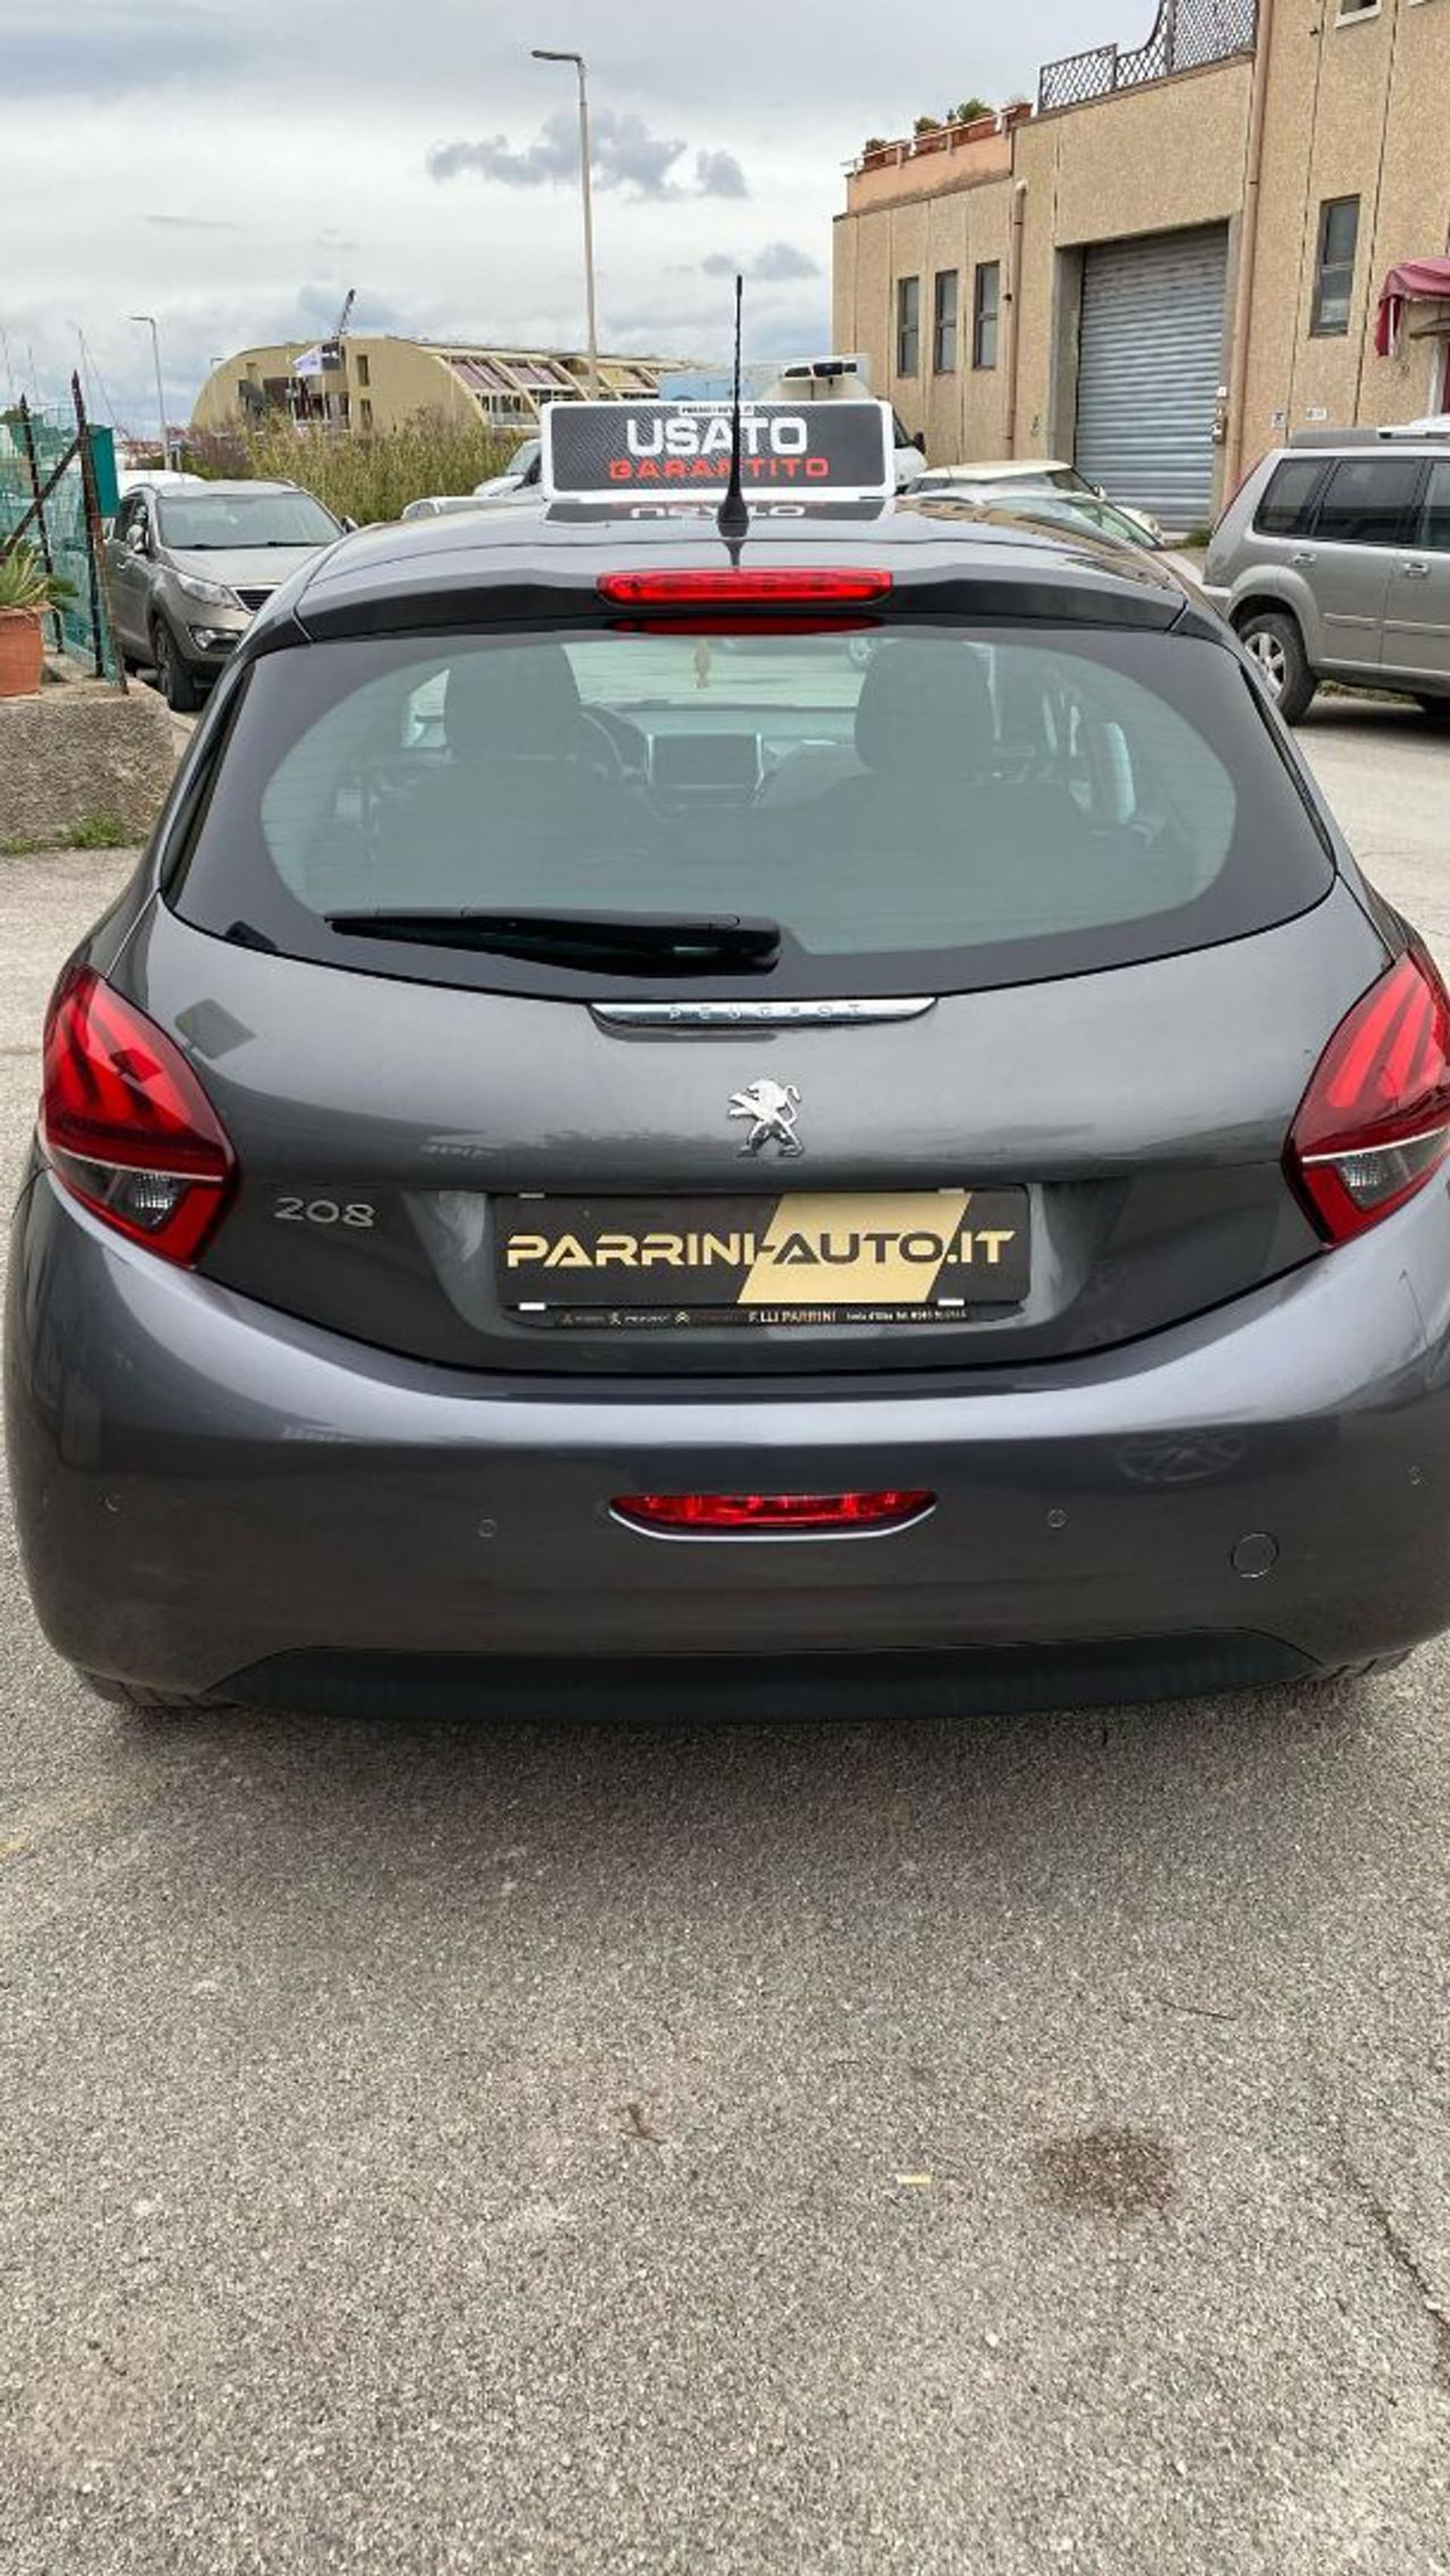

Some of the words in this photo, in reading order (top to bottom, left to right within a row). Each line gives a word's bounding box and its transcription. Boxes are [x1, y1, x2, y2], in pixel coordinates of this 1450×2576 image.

[626, 416, 807, 456] USATO
[670, 1003, 860, 1020] PEUGEOT
[274, 1196, 376, 1227] 208
[507, 1230, 1016, 1268] PARRINI-AUTO.IT
[782, 1311, 836, 1322] PARRINI
